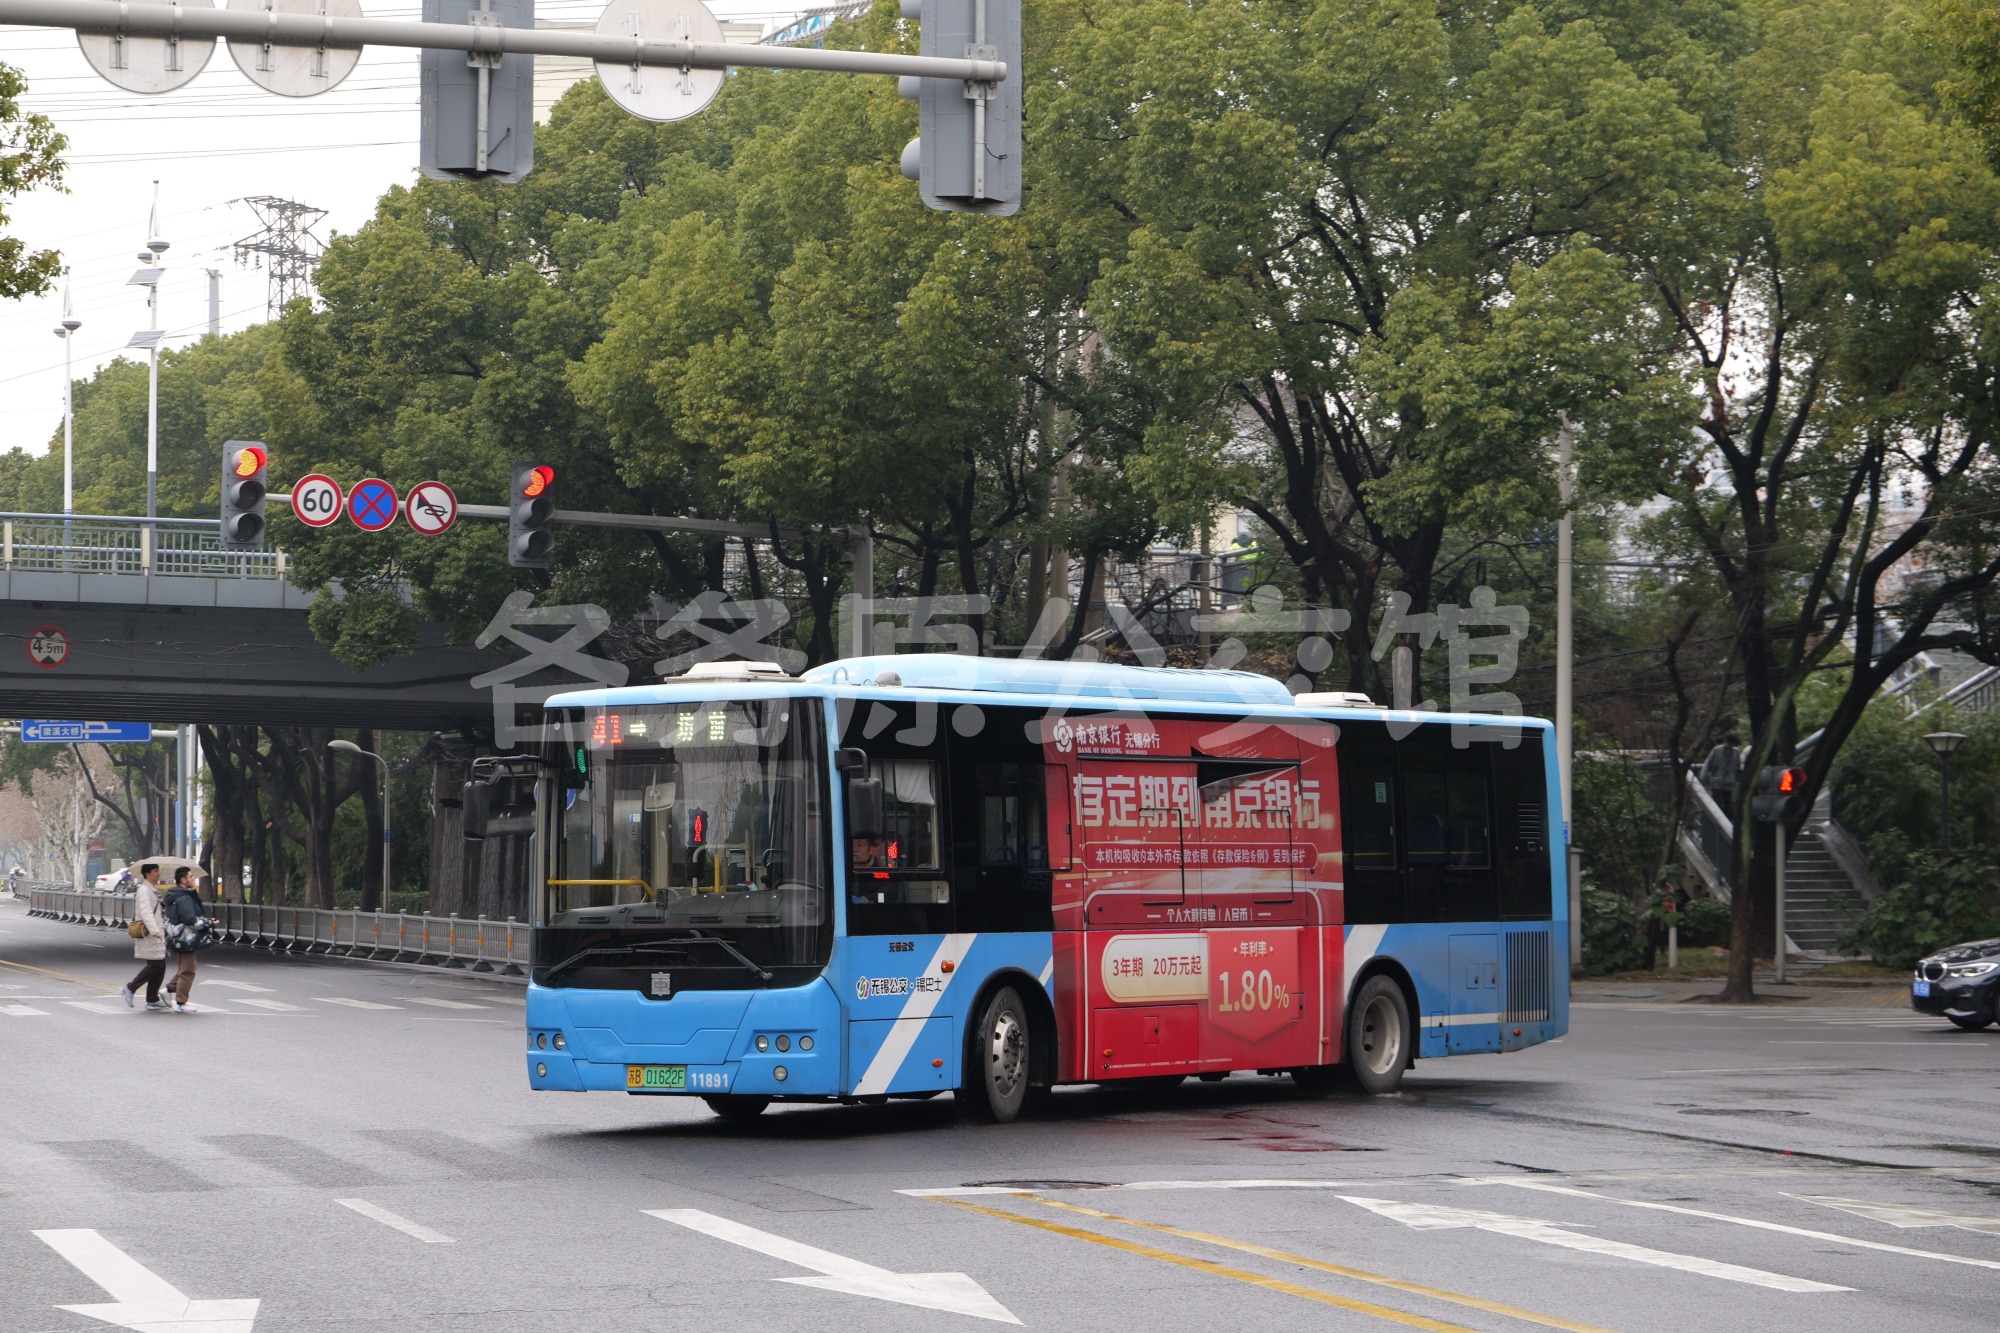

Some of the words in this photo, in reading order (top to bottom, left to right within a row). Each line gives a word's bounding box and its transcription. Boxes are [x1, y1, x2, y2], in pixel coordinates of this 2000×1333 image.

[303, 489, 333, 513] 60
[33, 636, 64, 654] 4.5m
[1076, 723, 1121, 746] 南京银行
[1125, 733, 1160, 748] 无锡分行
[1077, 746, 1092, 754] BANK
[1113, 957, 1143, 977] 3年期
[1153, 956, 1202, 976] 20万元起
[1219, 969, 1290, 1011] 1.80%
[692, 1073, 729, 1087] 11891
